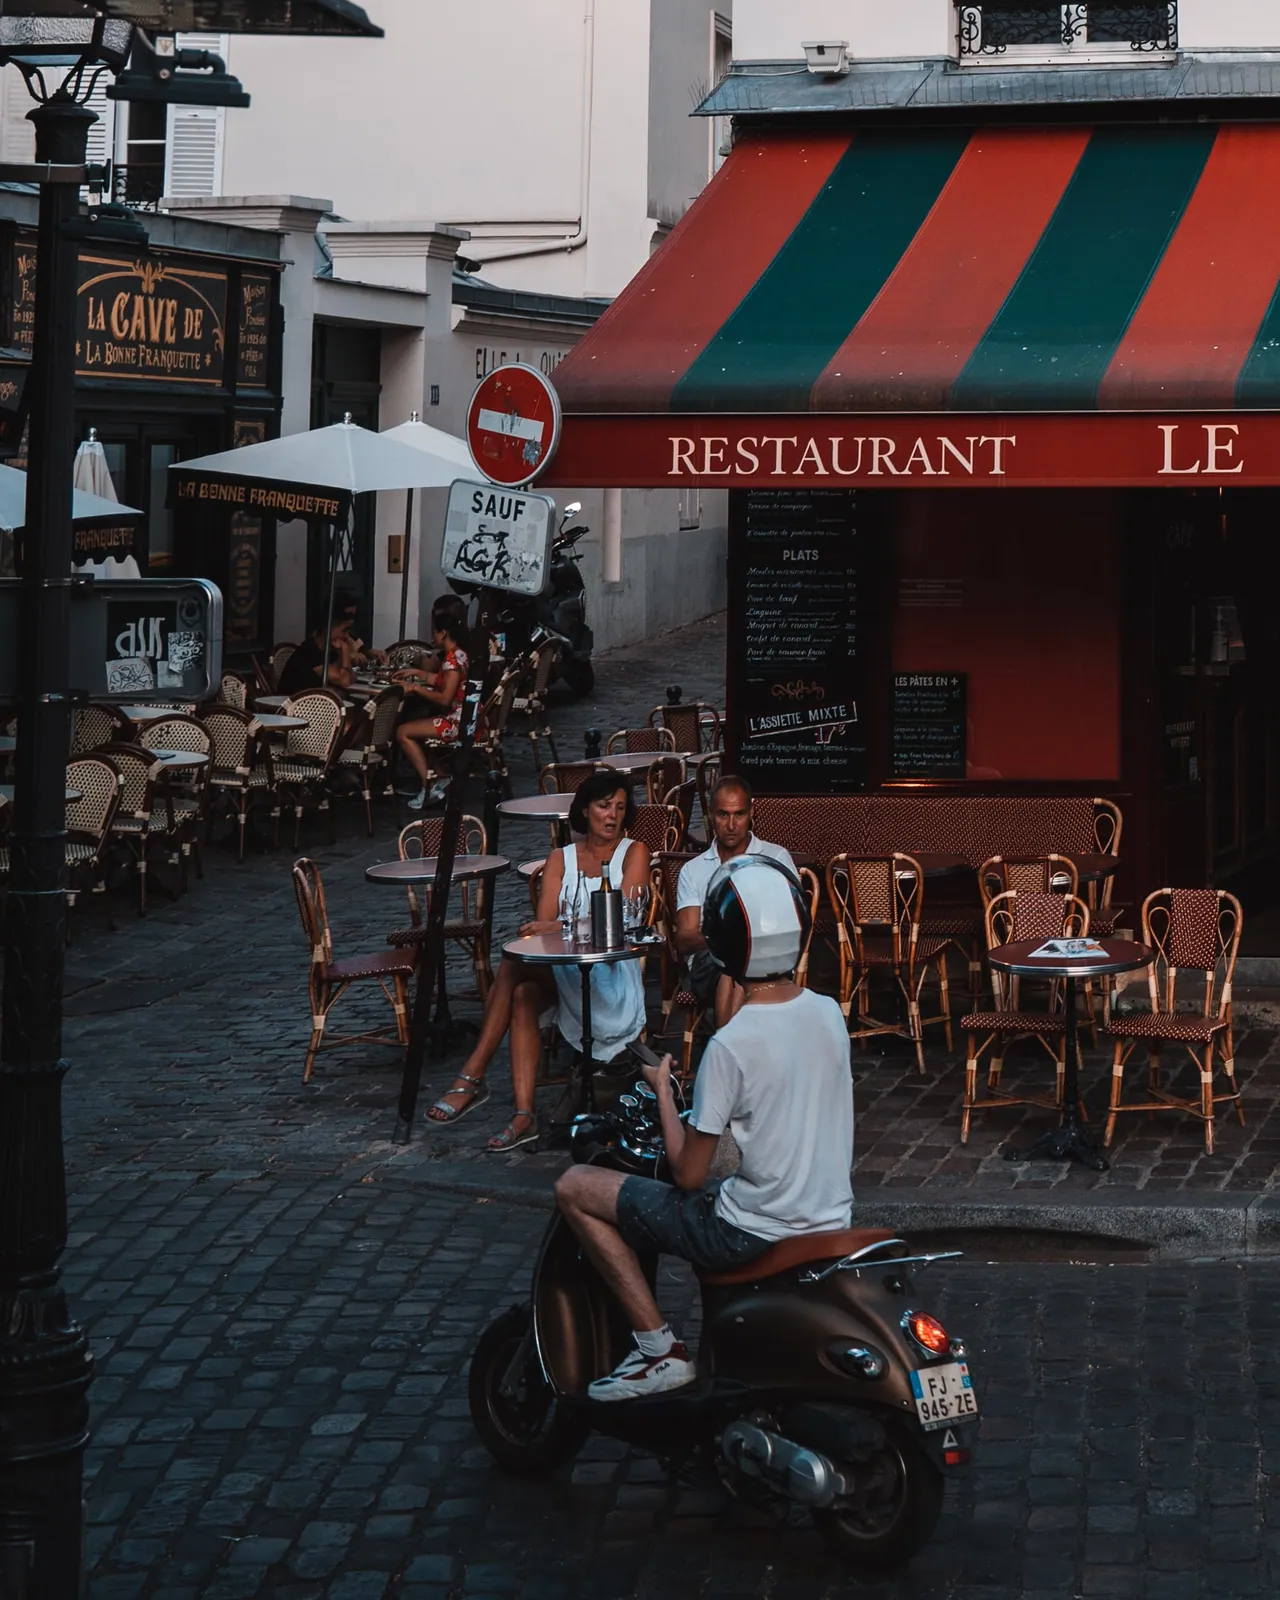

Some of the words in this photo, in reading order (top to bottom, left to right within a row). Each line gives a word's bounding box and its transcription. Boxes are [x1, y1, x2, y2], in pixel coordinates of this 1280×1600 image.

[243, 284, 266, 306] Maison
[87, 296, 106, 332] LA
[110, 290, 179, 345] CAVE
[183, 306, 204, 340] DE
[84, 339, 102, 365] LA
[103, 342, 137, 367] BONNE
[137, 343, 202, 373] FRANQUETTE
[667, 435, 1016, 476] RESTAURANT
[1156, 424, 1244, 474] LE
[178, 480, 195, 499] LA
[199, 482, 246, 504] BONNE
[250, 487, 340, 517] FRANQUETTE
[471, 490, 527, 522] SAUF
[782, 549, 819, 561] PLATS
[894, 677, 908, 687] LES
[909, 675, 933, 687] PÂTES
[935, 677, 948, 687] EN
[749, 711, 803, 732] L'ASSIETTE
[808, 704, 847, 722] MIXTE
[654, 1361, 671, 1375] FILA
